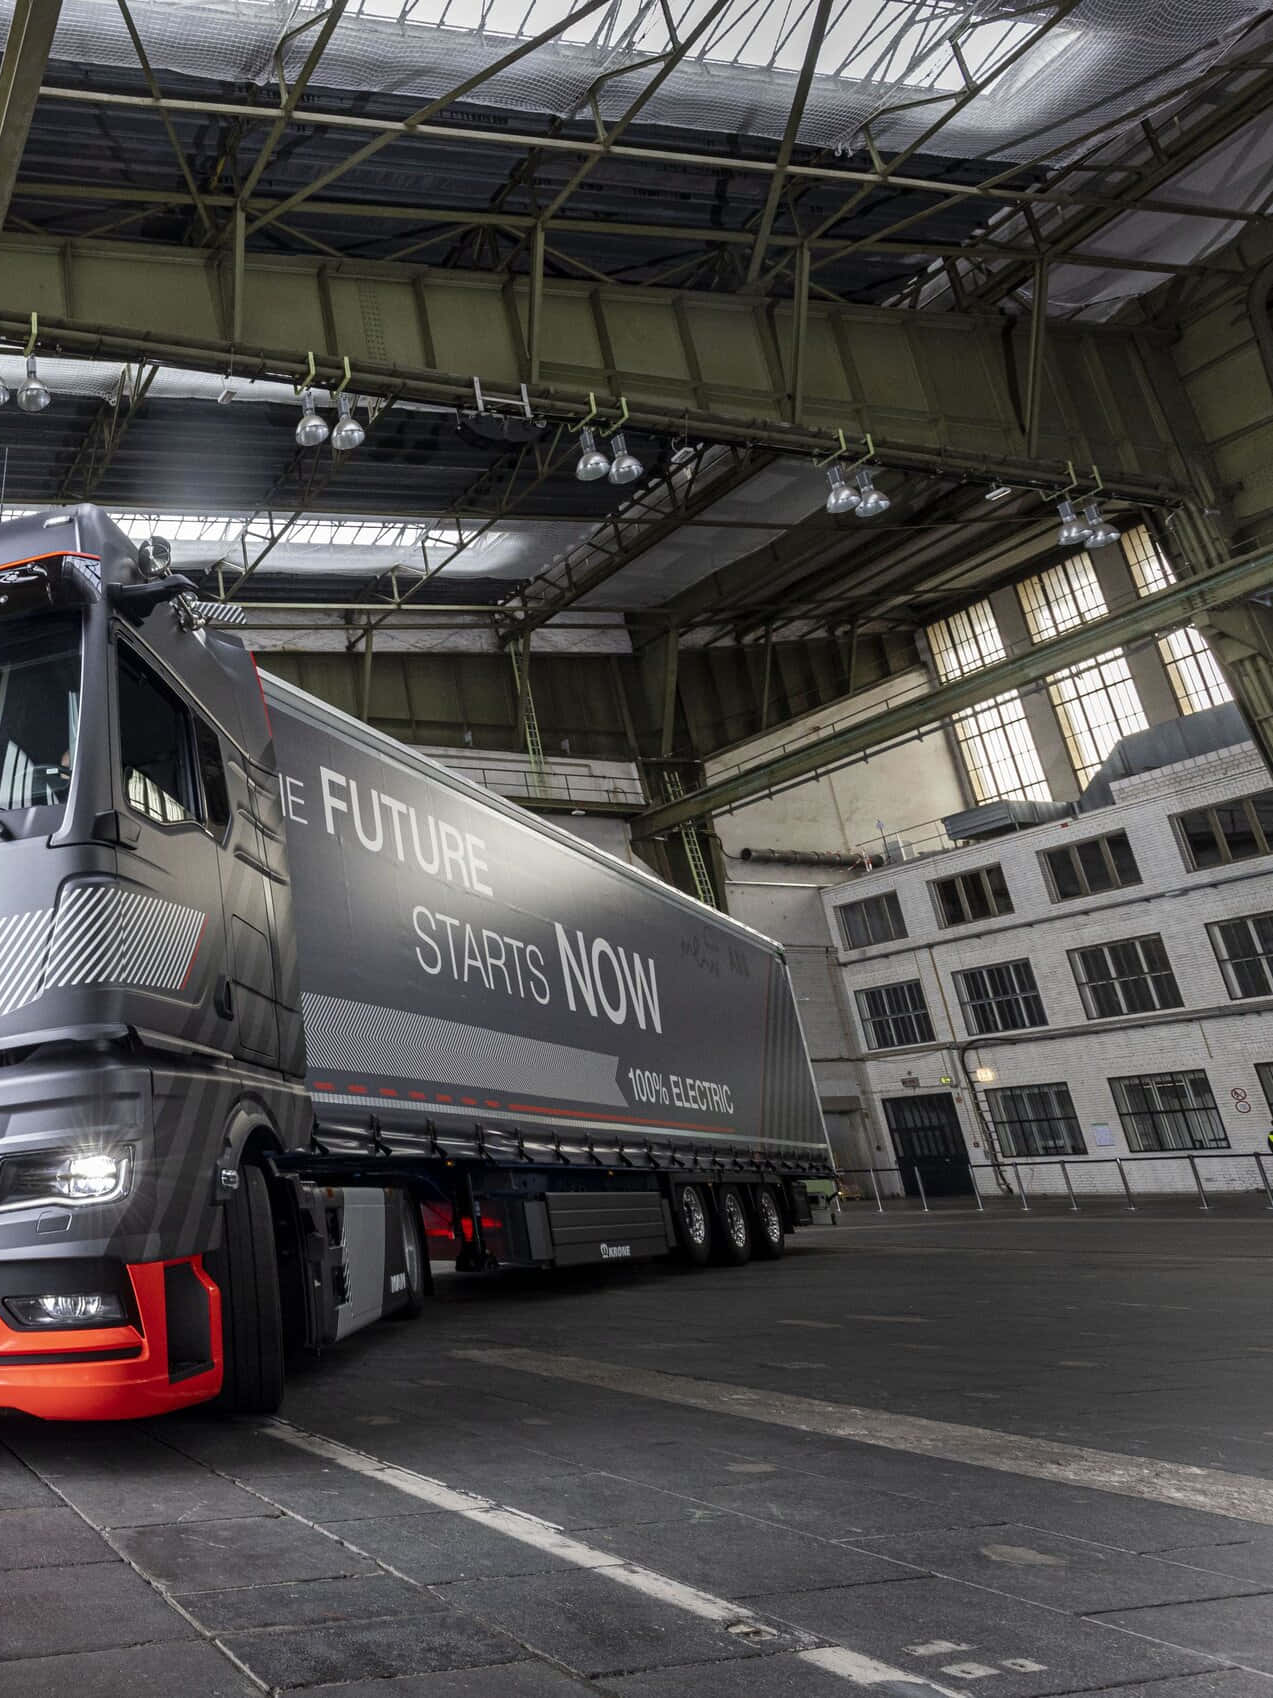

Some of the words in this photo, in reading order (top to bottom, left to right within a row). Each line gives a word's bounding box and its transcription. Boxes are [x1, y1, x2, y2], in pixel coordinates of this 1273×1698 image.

[320, 766, 493, 896] FUTURE
[413, 905, 550, 1005] STARTS
[555, 922, 663, 1034] NOW
[628, 1067, 669, 1104] 100%
[670, 1075, 734, 1114] ELECTRIC
